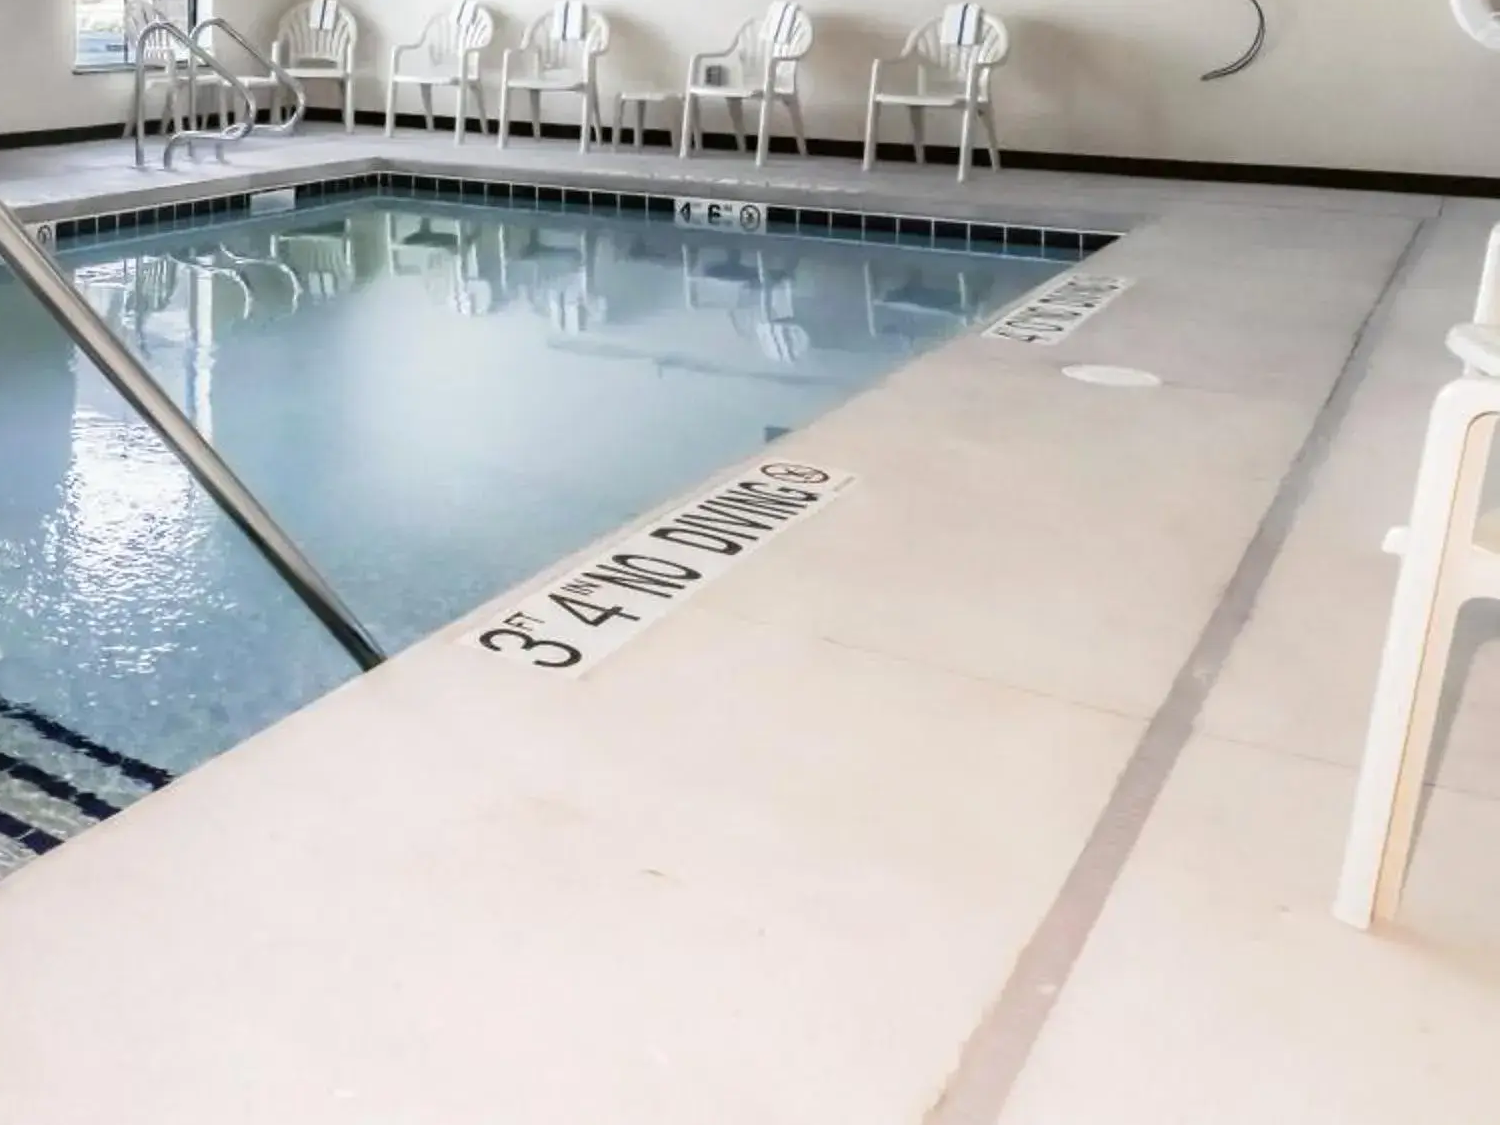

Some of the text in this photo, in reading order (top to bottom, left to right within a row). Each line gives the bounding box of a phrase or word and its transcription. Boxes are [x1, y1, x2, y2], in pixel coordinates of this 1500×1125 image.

[649, 481, 820, 557] DIVING
[582, 554, 703, 600] NO
[548, 592, 642, 627] 4
[479, 628, 582, 668] 3
